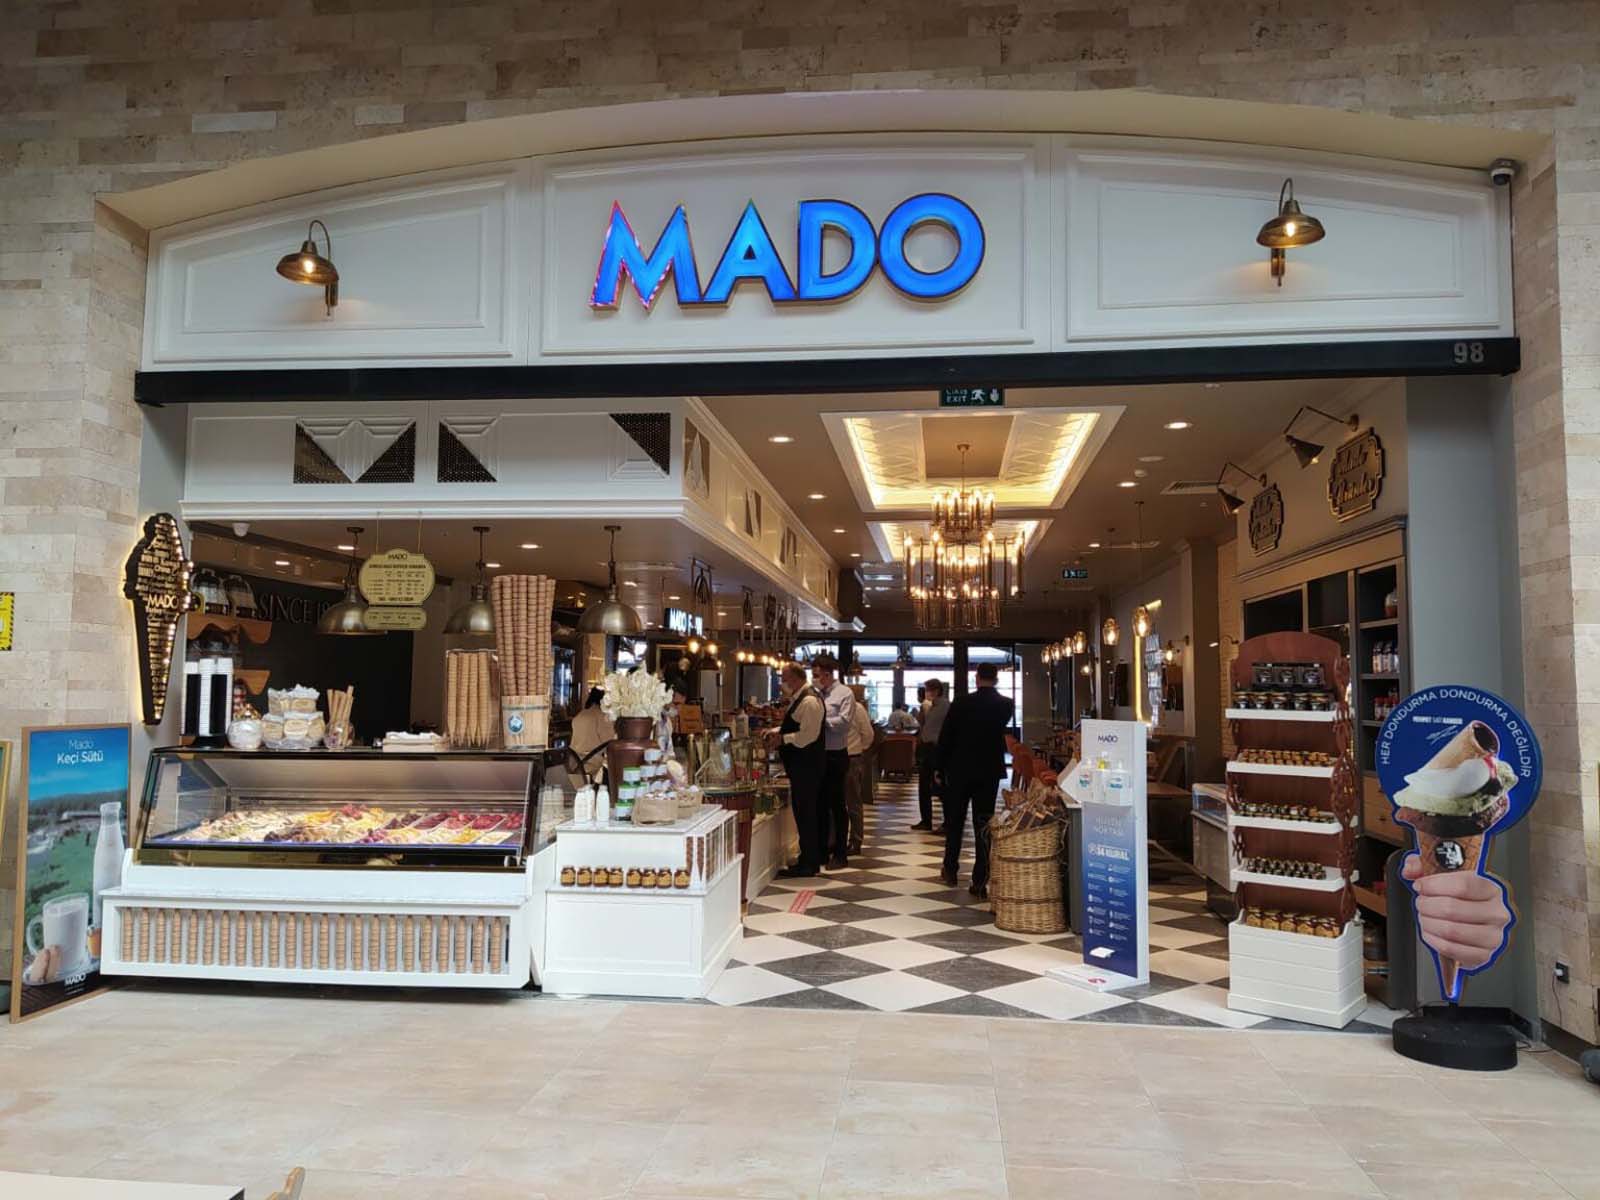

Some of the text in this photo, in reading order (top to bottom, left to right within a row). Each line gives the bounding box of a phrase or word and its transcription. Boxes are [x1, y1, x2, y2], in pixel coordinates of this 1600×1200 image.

[590, 192, 986, 310] MADO
[1454, 343, 1484, 363] 98
[946, 395, 967, 403] EXIT
[147, 593, 178, 609] MADO
[258, 592, 313, 624] SINCE
[1384, 690, 1438, 741] DONDURMA
[1439, 688, 1509, 723] DONDURMA
[68, 739, 95, 750] Mado
[1098, 735, 1118, 744] MADO
[1506, 720, 1532, 778] DEĞİLDİR
[56, 749, 104, 765] Keçi Sütü
[1380, 741, 1391, 765] HER
[64, 972, 87, 986] MADO
